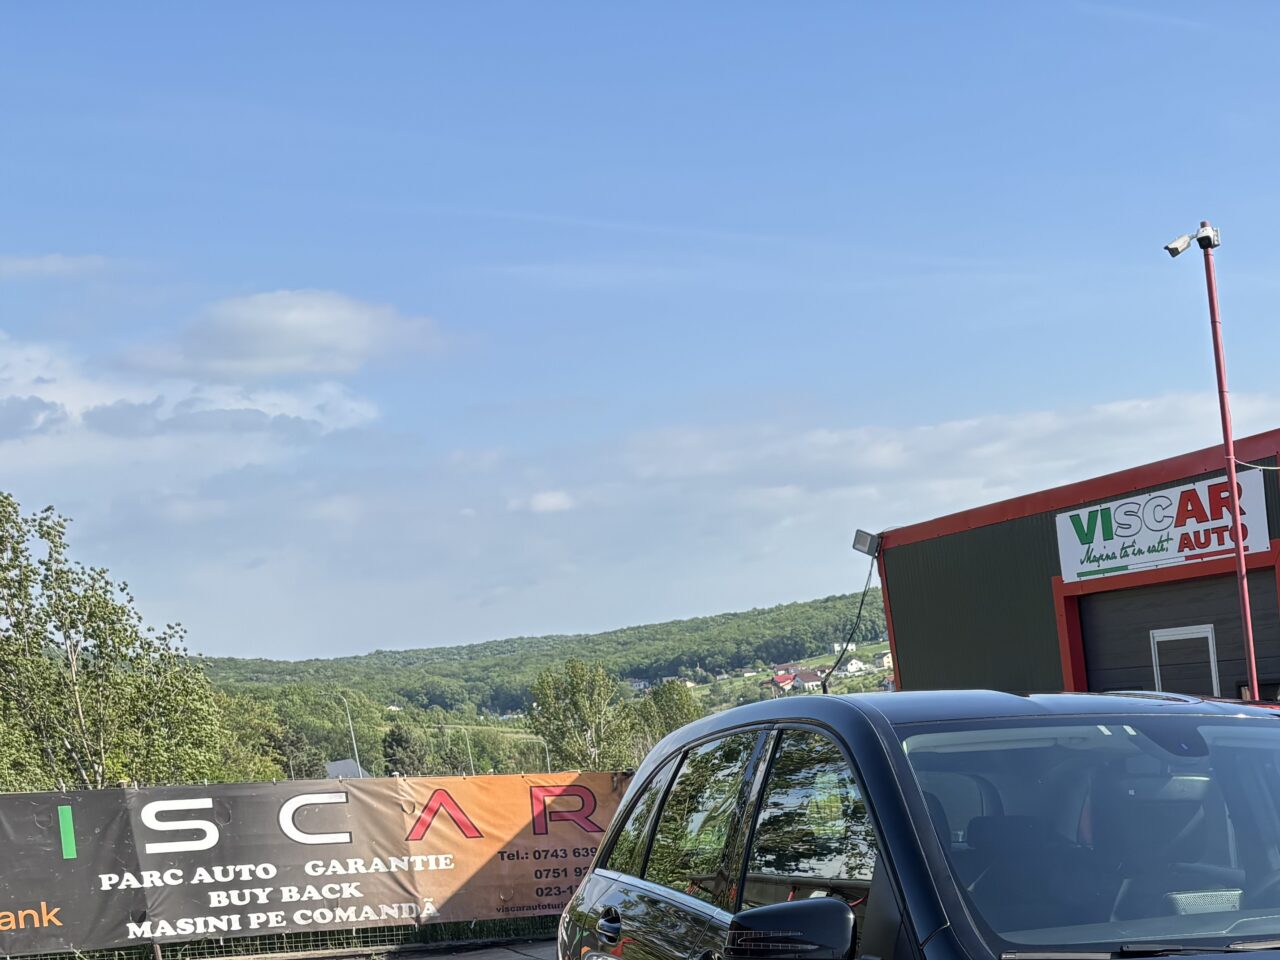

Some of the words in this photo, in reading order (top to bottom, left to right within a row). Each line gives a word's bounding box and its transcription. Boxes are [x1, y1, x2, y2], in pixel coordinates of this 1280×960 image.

[1069, 481, 1247, 545] VISCAR
[1177, 523, 1249, 552] AUTO
[497, 850, 529, 861] Tel.:
[532, 848, 569, 860] 0743
[98, 868, 184, 891] PARC
[190, 863, 277, 885] AUTO
[304, 854, 456, 877] GARANTIE
[534, 868, 568, 880] 0751
[208, 887, 274, 908] BUY
[280, 882, 364, 903] BACK
[126, 914, 242, 940] MASINI
[247, 911, 287, 929] PE
